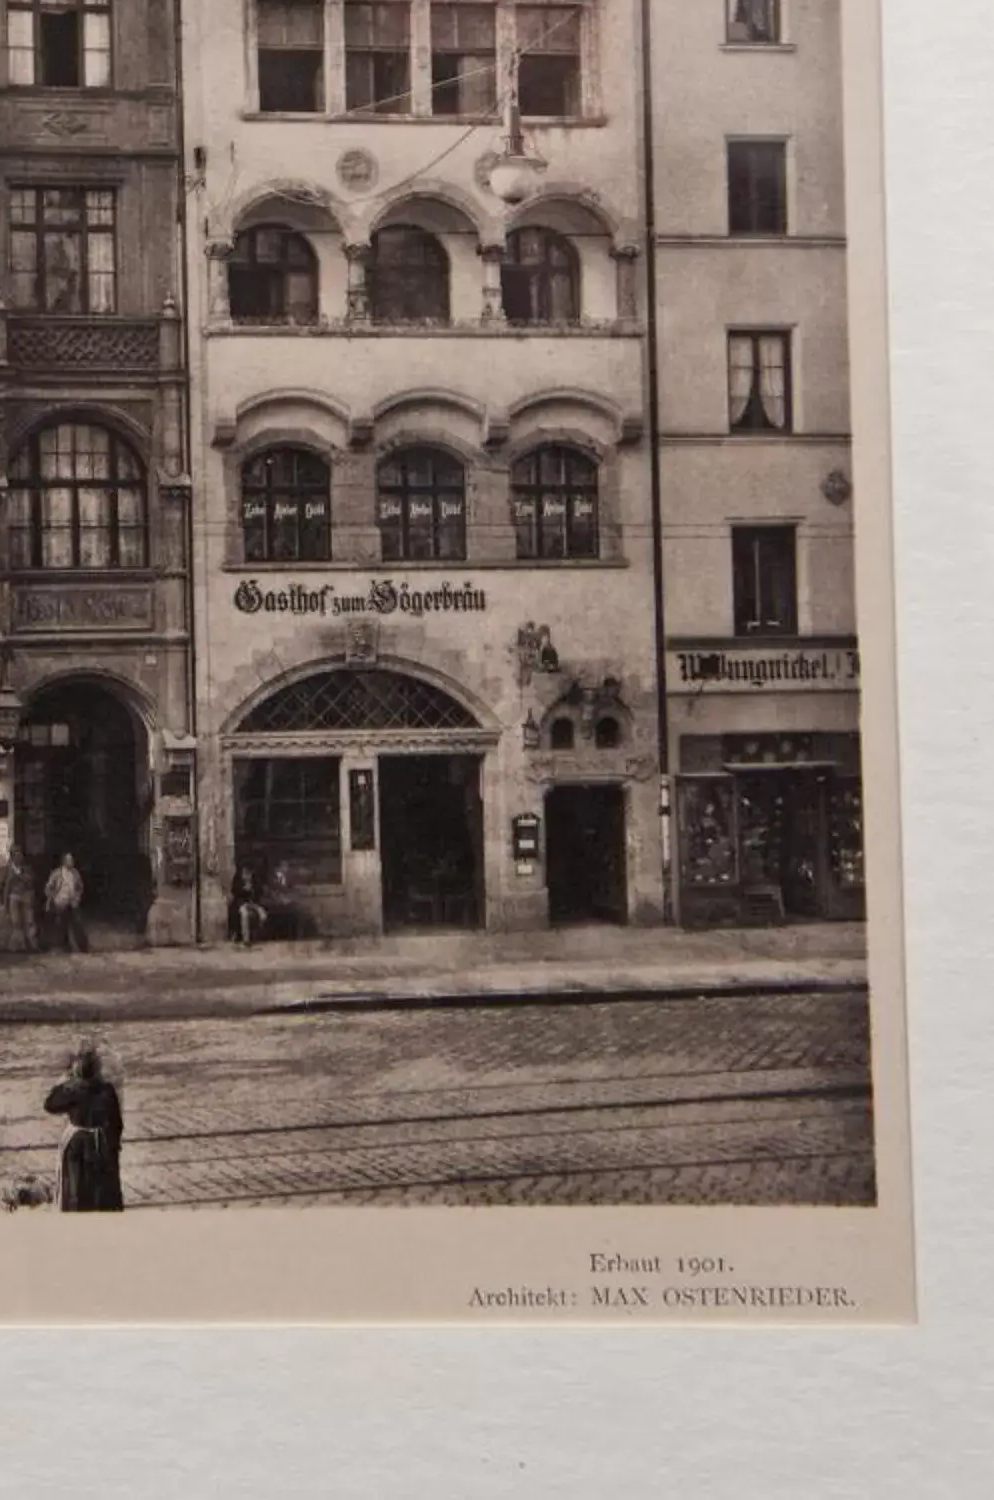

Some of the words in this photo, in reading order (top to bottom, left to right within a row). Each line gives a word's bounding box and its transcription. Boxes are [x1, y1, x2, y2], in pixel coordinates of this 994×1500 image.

[234, 579, 334, 616] Gasthof
[333, 593, 365, 617] zum
[589, 1252, 662, 1274] Erbaut
[677, 1257, 735, 1277] 1901.
[468, 1285, 578, 1309] Architekt:
[590, 1286, 649, 1307] MAX
[661, 1286, 856, 1308] OSTENRIEDER.
